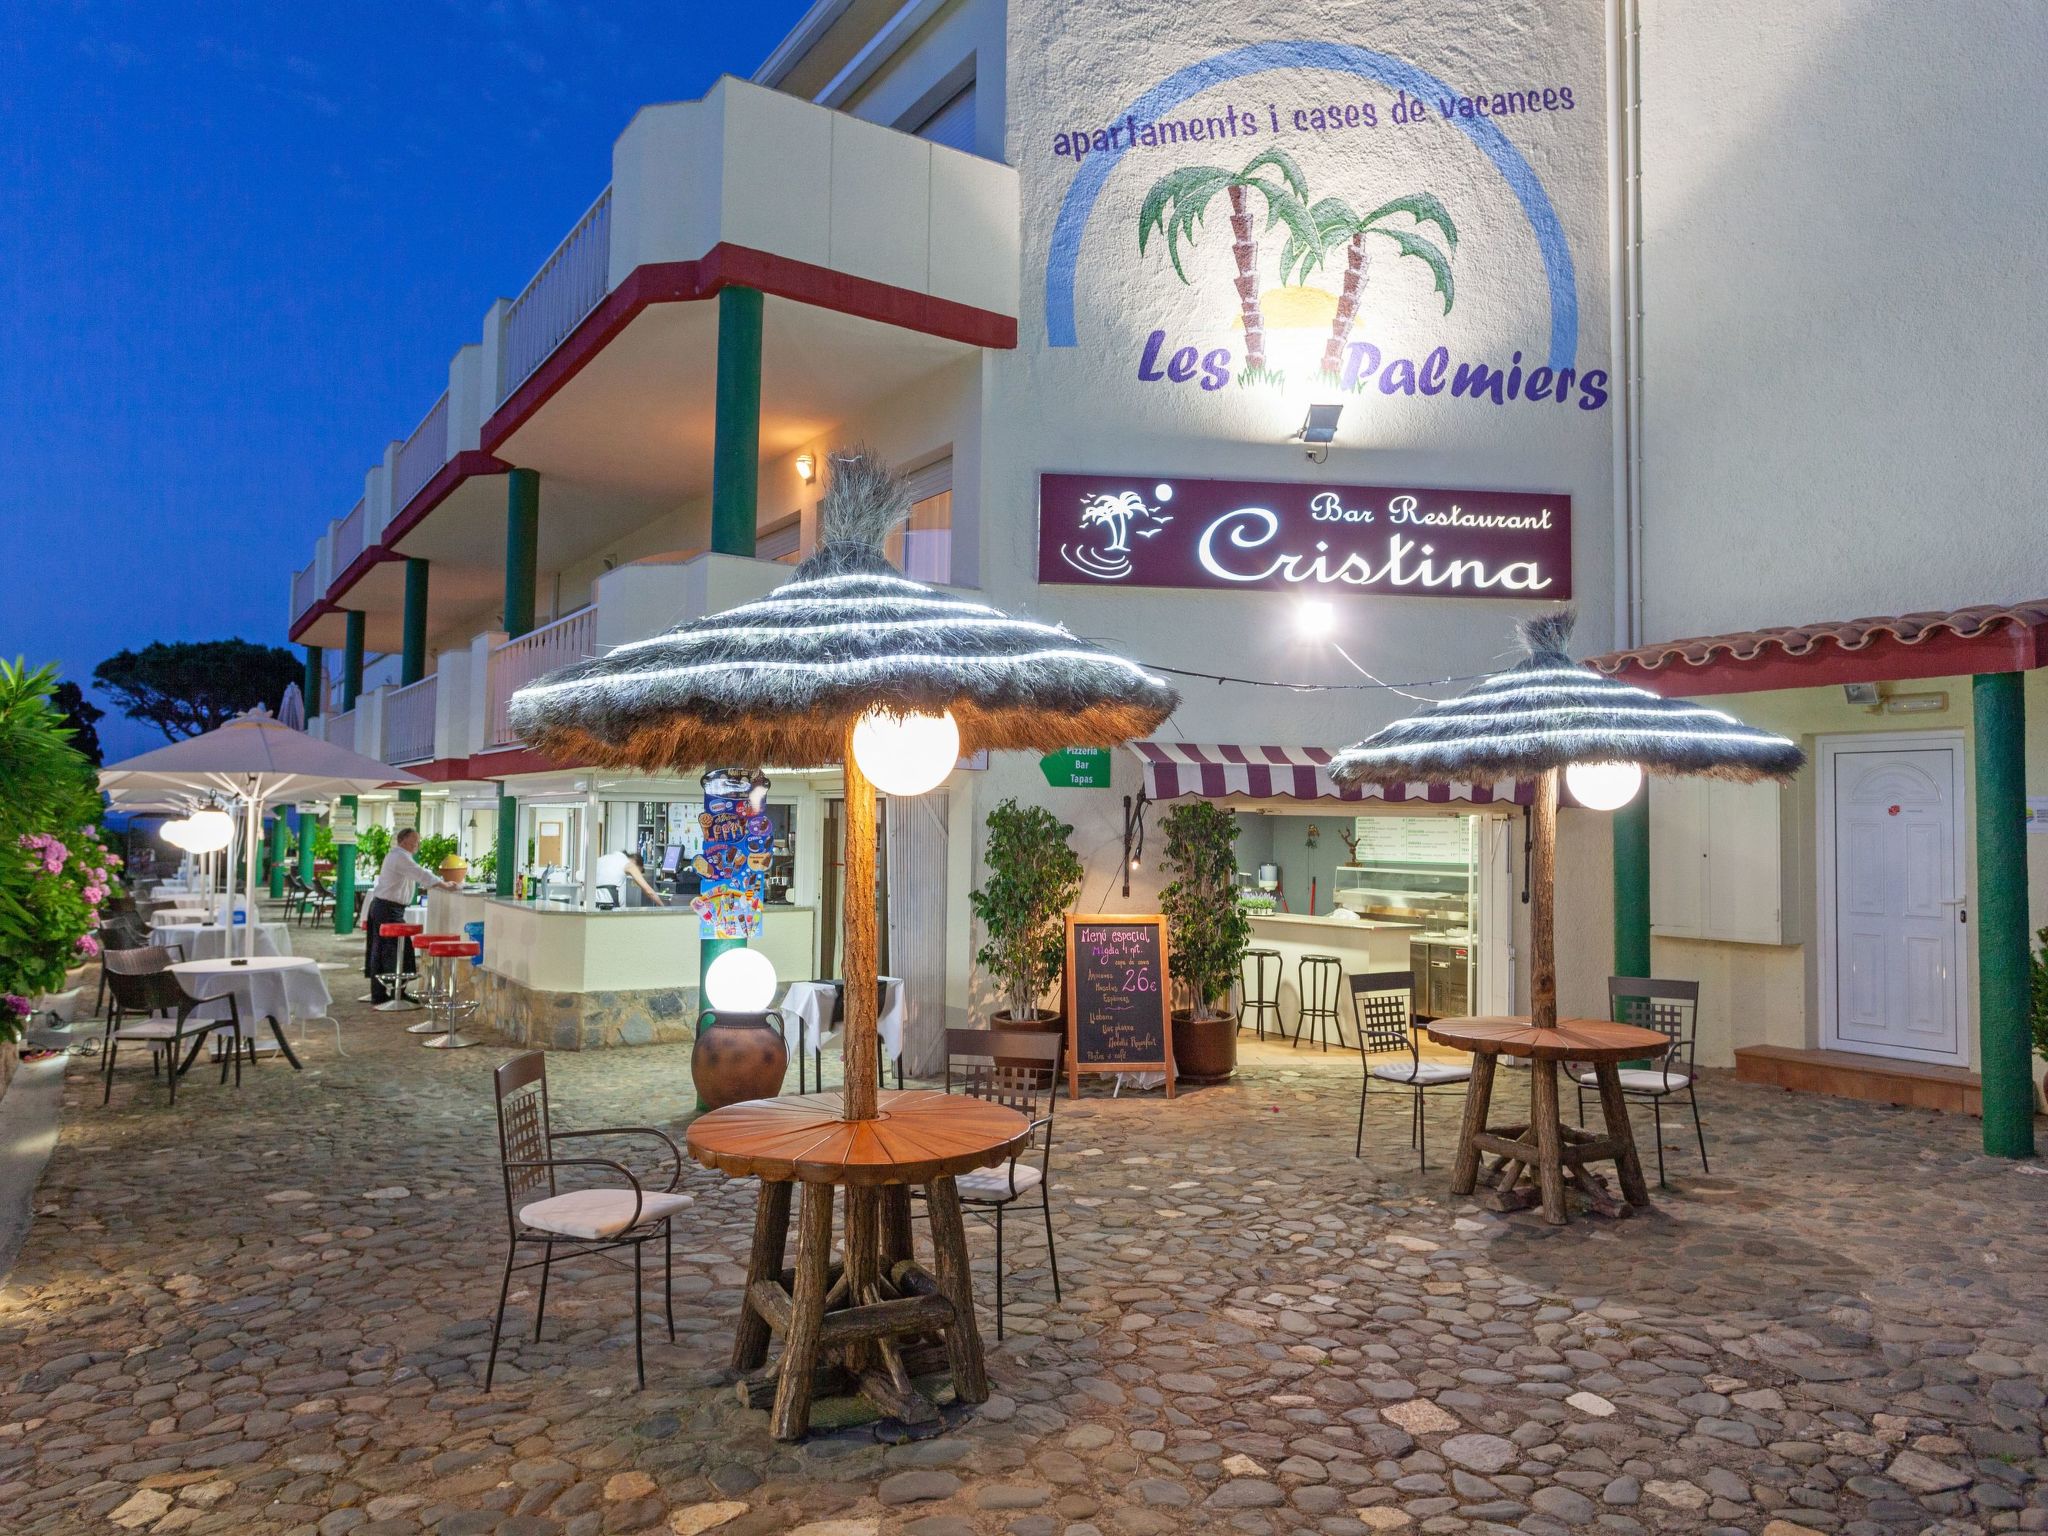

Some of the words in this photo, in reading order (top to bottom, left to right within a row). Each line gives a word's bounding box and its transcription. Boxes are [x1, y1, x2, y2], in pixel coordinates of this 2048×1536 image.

[1053, 104, 1258, 162] apartaments
[1268, 103, 1279, 133] i
[1293, 102, 1378, 132] cases
[1391, 90, 1426, 124] de
[1438, 86, 1576, 119] vacances
[1138, 329, 1232, 392] Les
[1339, 341, 1609, 412] Palmiers
[1310, 491, 1375, 523] Bar
[1388, 495, 1552, 530] Restaurant
[1198, 506, 1553, 591] Cristina
[1066, 746, 1098, 756] Pizzeria
[1075, 760, 1089, 769] Bar
[1070, 773, 1093, 786] Tapas
[1081, 927, 1107, 945] Menú
[1111, 926, 1151, 951] especial
